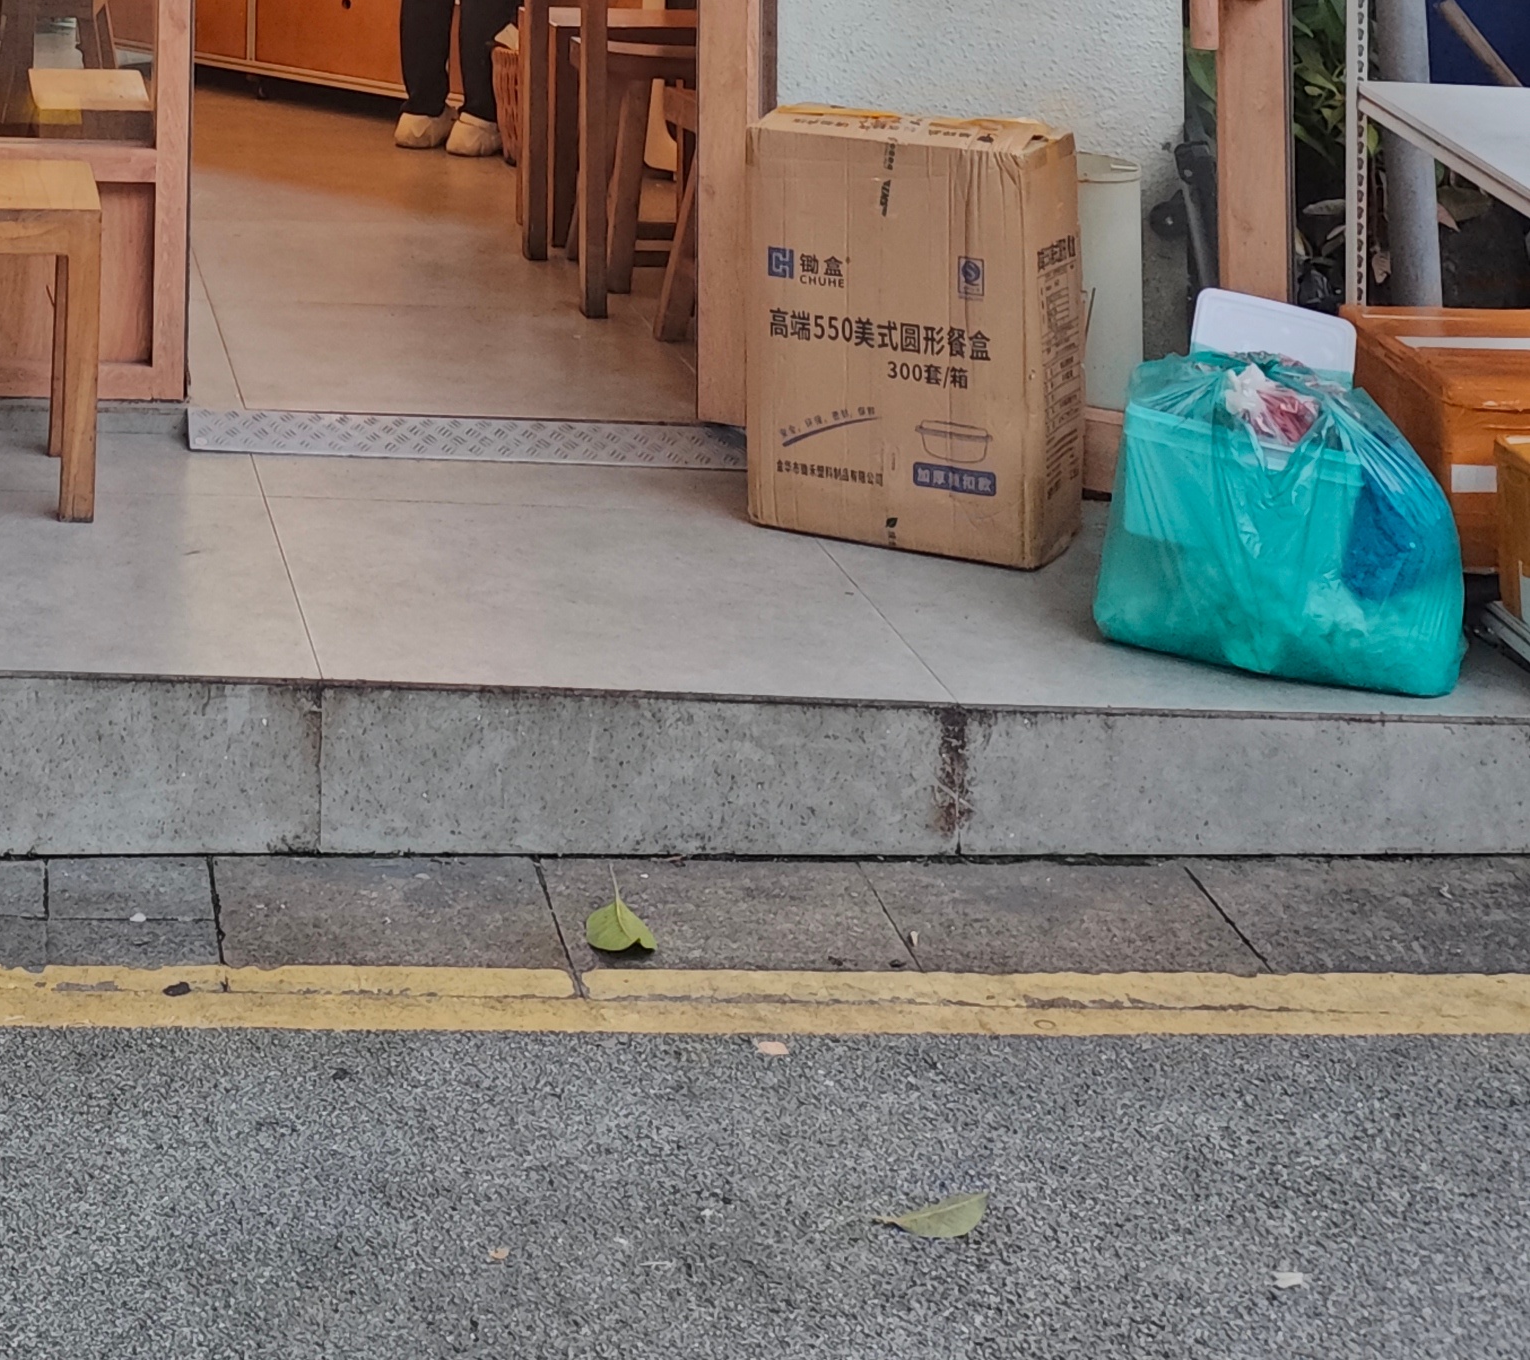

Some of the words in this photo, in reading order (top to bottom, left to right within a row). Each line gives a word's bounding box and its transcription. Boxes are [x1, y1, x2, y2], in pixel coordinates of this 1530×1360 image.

[799, 274, 845, 289] CHUHE
[769, 307, 992, 362] 高端550美式圆形餐盒
[886, 361, 969, 390] 300套/箱
